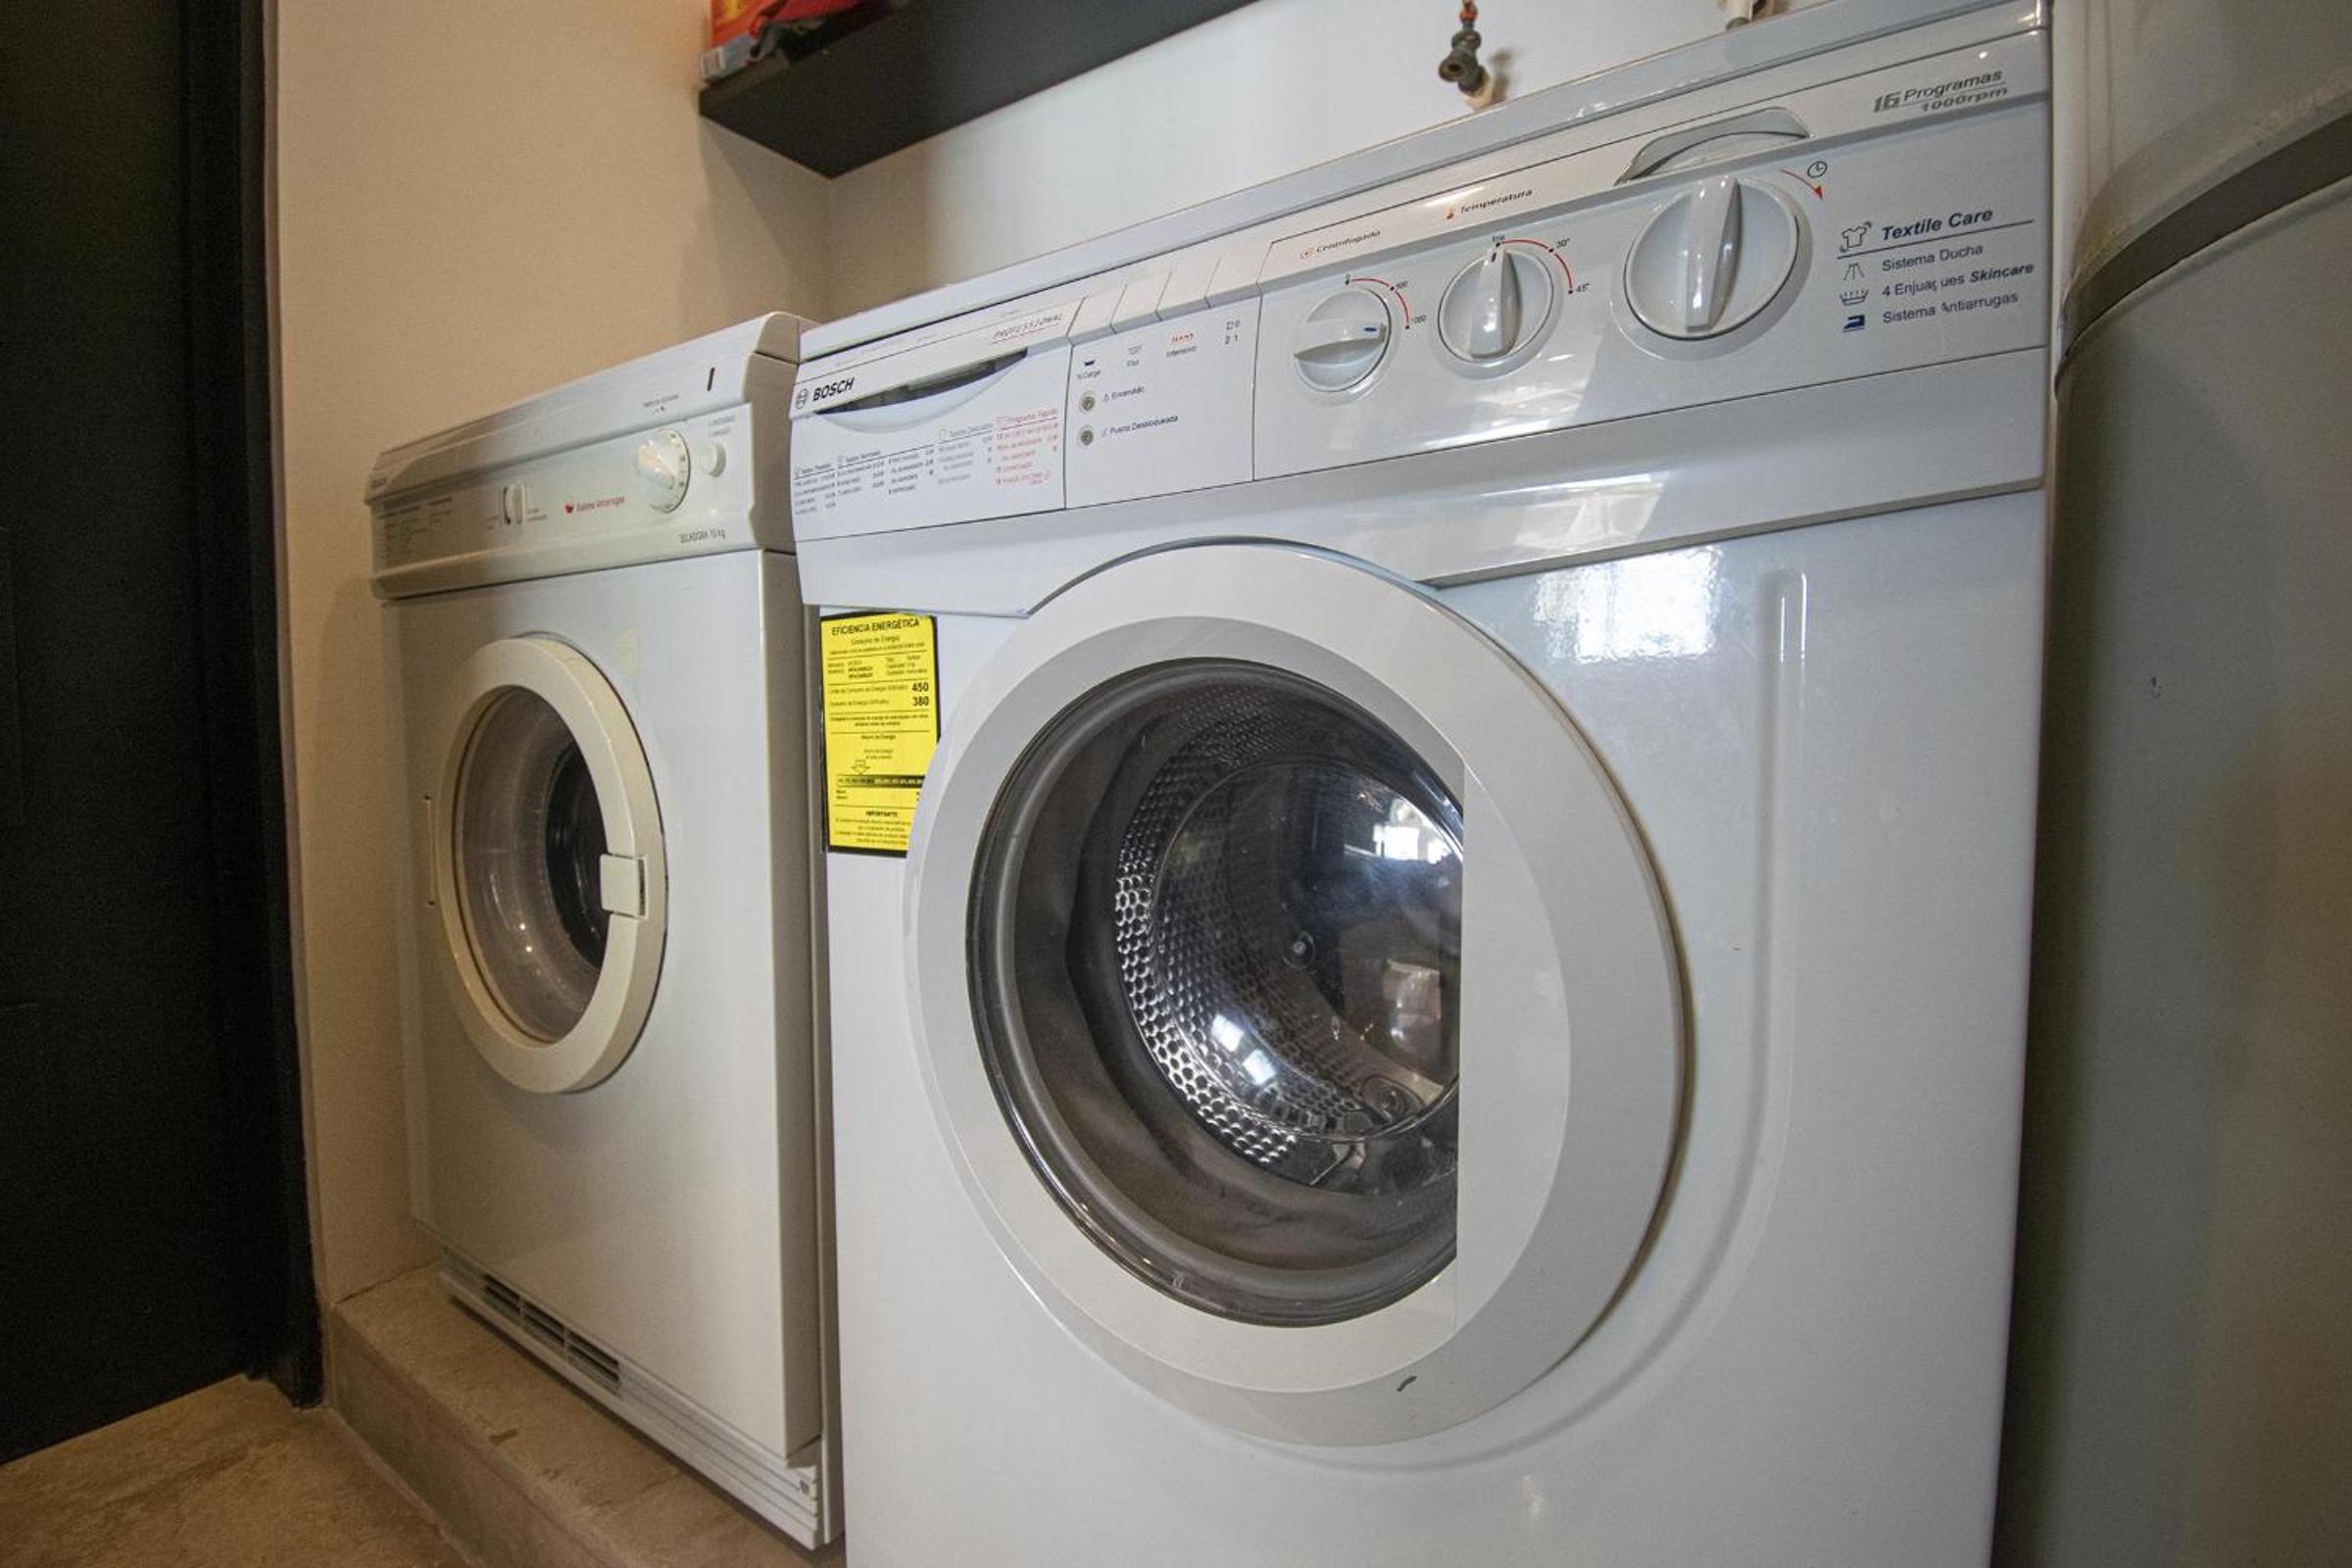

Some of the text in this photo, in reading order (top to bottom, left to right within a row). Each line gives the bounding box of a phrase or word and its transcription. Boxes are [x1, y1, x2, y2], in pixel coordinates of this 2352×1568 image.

[1873, 71, 2004, 114] 16 Programas
[1922, 86, 2008, 112] 1000rpm
[1459, 188, 1534, 214] Temperatura
[1882, 209, 1993, 241] Textile Care
[1882, 244, 1984, 272] Sistema Ducha
[1882, 284, 1891, 297] 4
[1970, 263, 2034, 283] Skincare
[1883, 305, 1936, 324] Sistema
[811, 376, 856, 403] BOSCH
[831, 623, 870, 636] EFICIENCIA
[911, 681, 929, 692] 450
[911, 695, 930, 707] 380
